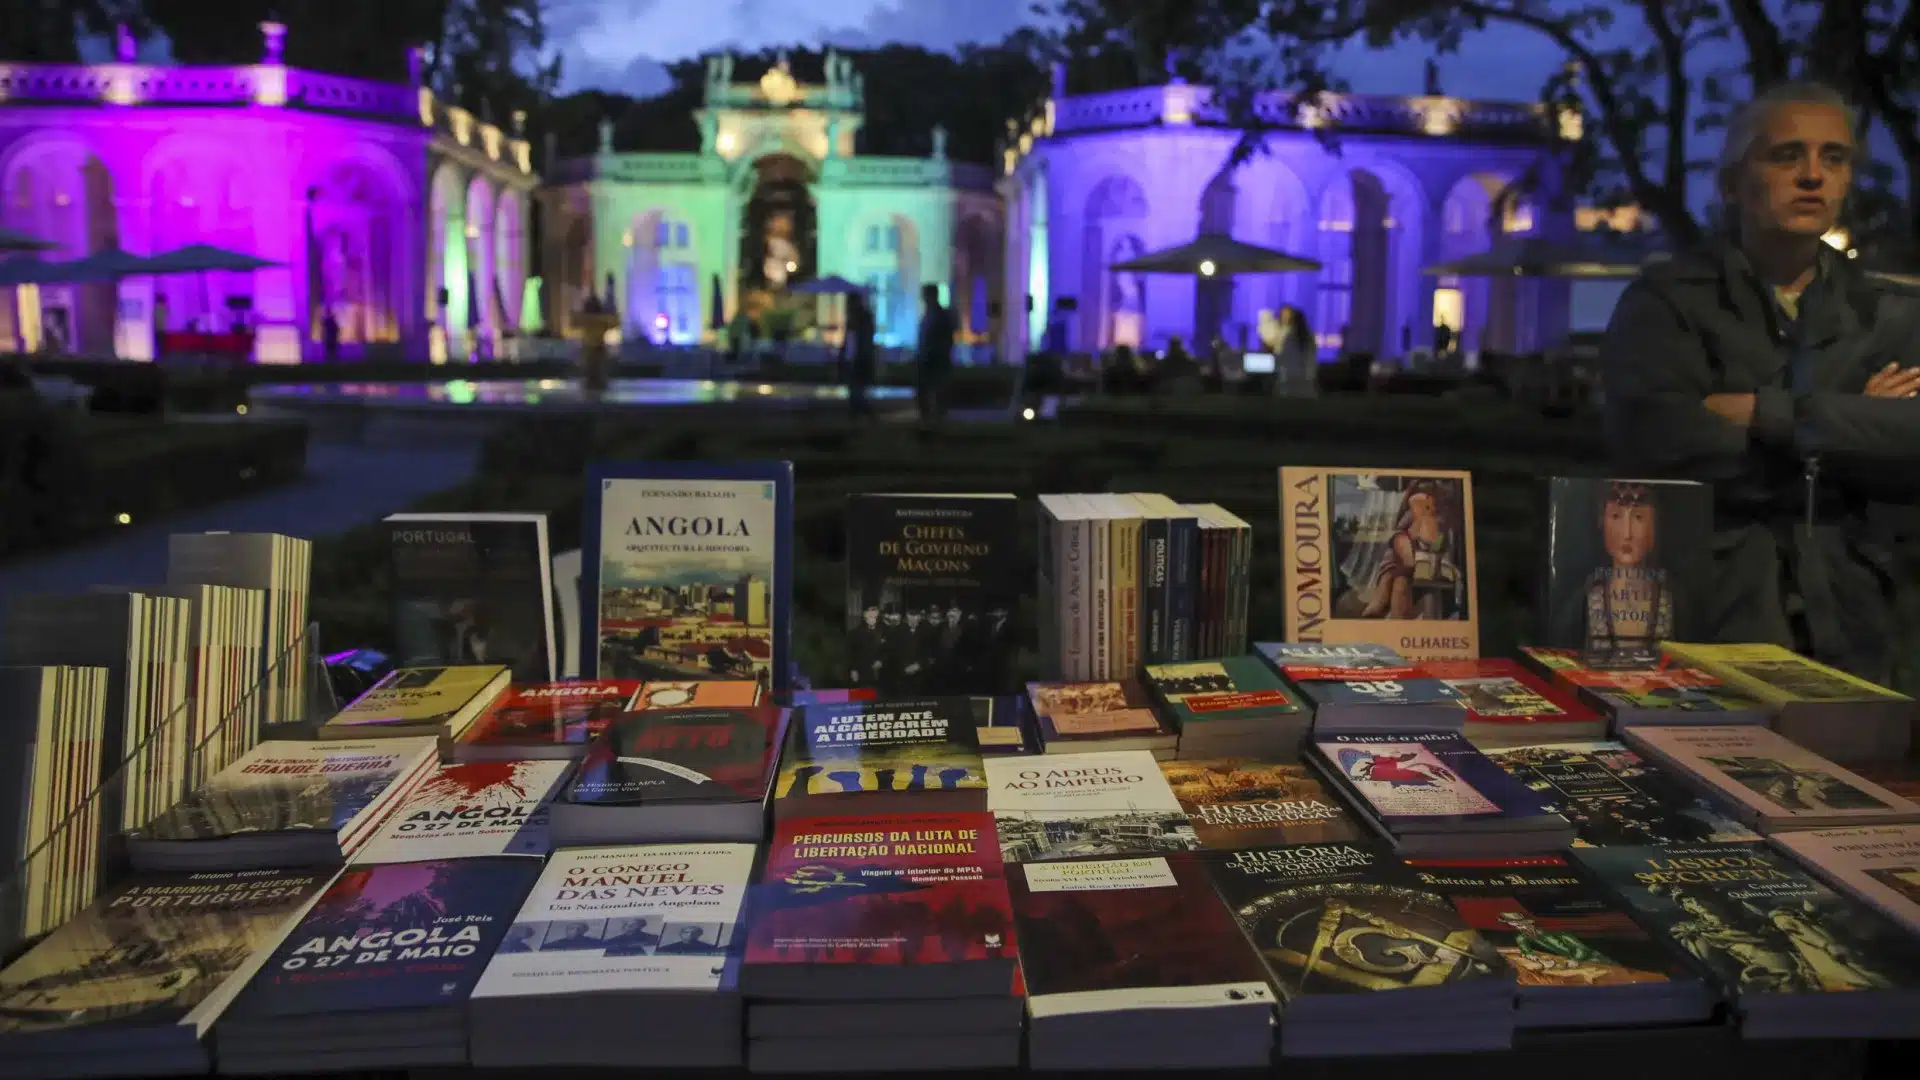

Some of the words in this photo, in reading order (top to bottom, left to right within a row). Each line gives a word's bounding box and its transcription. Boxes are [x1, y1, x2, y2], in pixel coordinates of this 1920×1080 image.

[641, 489, 692, 498] FERNANDO
[694, 489, 737, 498] BATALHA
[625, 516, 751, 537] ANGOLA
[392, 530, 476, 545] PORTUGAL
[625, 543, 695, 553] ARQUITECTURA
[880, 541, 901, 556] DE
[905, 540, 990, 556] GOVERNO
[898, 557, 971, 576] MAÇONS
[1400, 636, 1470, 650] OLHARES
[519, 686, 620, 698] ANGOLA
[830, 712, 894, 725] LUTEM
[899, 709, 934, 721] ATÉ
[814, 718, 949, 734] ALCANÇAREM
[816, 733, 831, 743] A
[835, 727, 948, 742] LIBERDADE
[1355, 735, 1385, 743] que
[241, 764, 322, 775] GRANDE
[320, 759, 393, 773] GUERRA
[1018, 770, 1040, 780] O
[1045, 767, 1122, 779] ADEUS
[1004, 780, 1038, 790] AO
[1045, 774, 1144, 790] IMPÉRIO
[1198, 799, 1328, 815] HISTÓRIA
[398, 823, 417, 832] O
[423, 822, 450, 831] 27
[456, 820, 483, 829] DE
[486, 817, 549, 827] MAIO
[1204, 817, 1233, 825] EM
[1237, 811, 1338, 824] PORTUGAL
[390, 831, 441, 840] Memórias
[442, 830, 455, 838] de
[792, 831, 885, 845] PERCURSOS
[889, 831, 912, 843] DA
[915, 830, 953, 842] LUTA
[958, 829, 978, 841] DE
[576, 853, 599, 861] JOSÉ
[600, 852, 639, 860] MANUEL
[658, 850, 701, 858] SILVEIRA
[793, 843, 889, 859] LIBERTAÇÃO
[894, 842, 977, 856] NACIONAL
[1233, 845, 1361, 863] HISTÓRIA
[1051, 861, 1130, 871] INQUISIÇÃO
[1132, 860, 1153, 868] EM
[1243, 853, 1376, 868] FRANCO-MAÇONARIA
[1243, 867, 1272, 875] EM
[1275, 858, 1374, 872] PORTUGAL
[1645, 856, 1774, 871] LISBOA
[236, 868, 280, 878] Ventura
[567, 866, 584, 875] O
[592, 863, 690, 875] CÓNEGO
[860, 869, 893, 878] Viagem
[907, 868, 942, 876] interior
[957, 866, 983, 874] MPLA
[1061, 866, 1135, 876] PORTUGAL
[1634, 868, 1793, 884] SECRETA
[127, 886, 141, 895] A
[143, 883, 221, 895] MARINHA
[221, 882, 243, 892] DE
[244, 876, 314, 890] GUERRA
[561, 872, 695, 887] MANUEL
[911, 875, 949, 883] Memórias
[950, 874, 984, 882] Pessoais
[556, 888, 619, 901] DAS
[628, 884, 725, 899] NEVES
[1747, 882, 1791, 891] Capital
[110, 885, 304, 907] PORTUGUESA
[548, 904, 572, 912] Um
[576, 901, 655, 911] Nacionalista
[659, 899, 721, 909] Angolano
[432, 914, 462, 925] José
[463, 914, 493, 923] Reis
[292, 925, 481, 955] ANGOLA
[282, 957, 301, 970] O
[313, 954, 350, 968] 27
[355, 949, 389, 965] DE
[397, 943, 478, 961] MAIO
